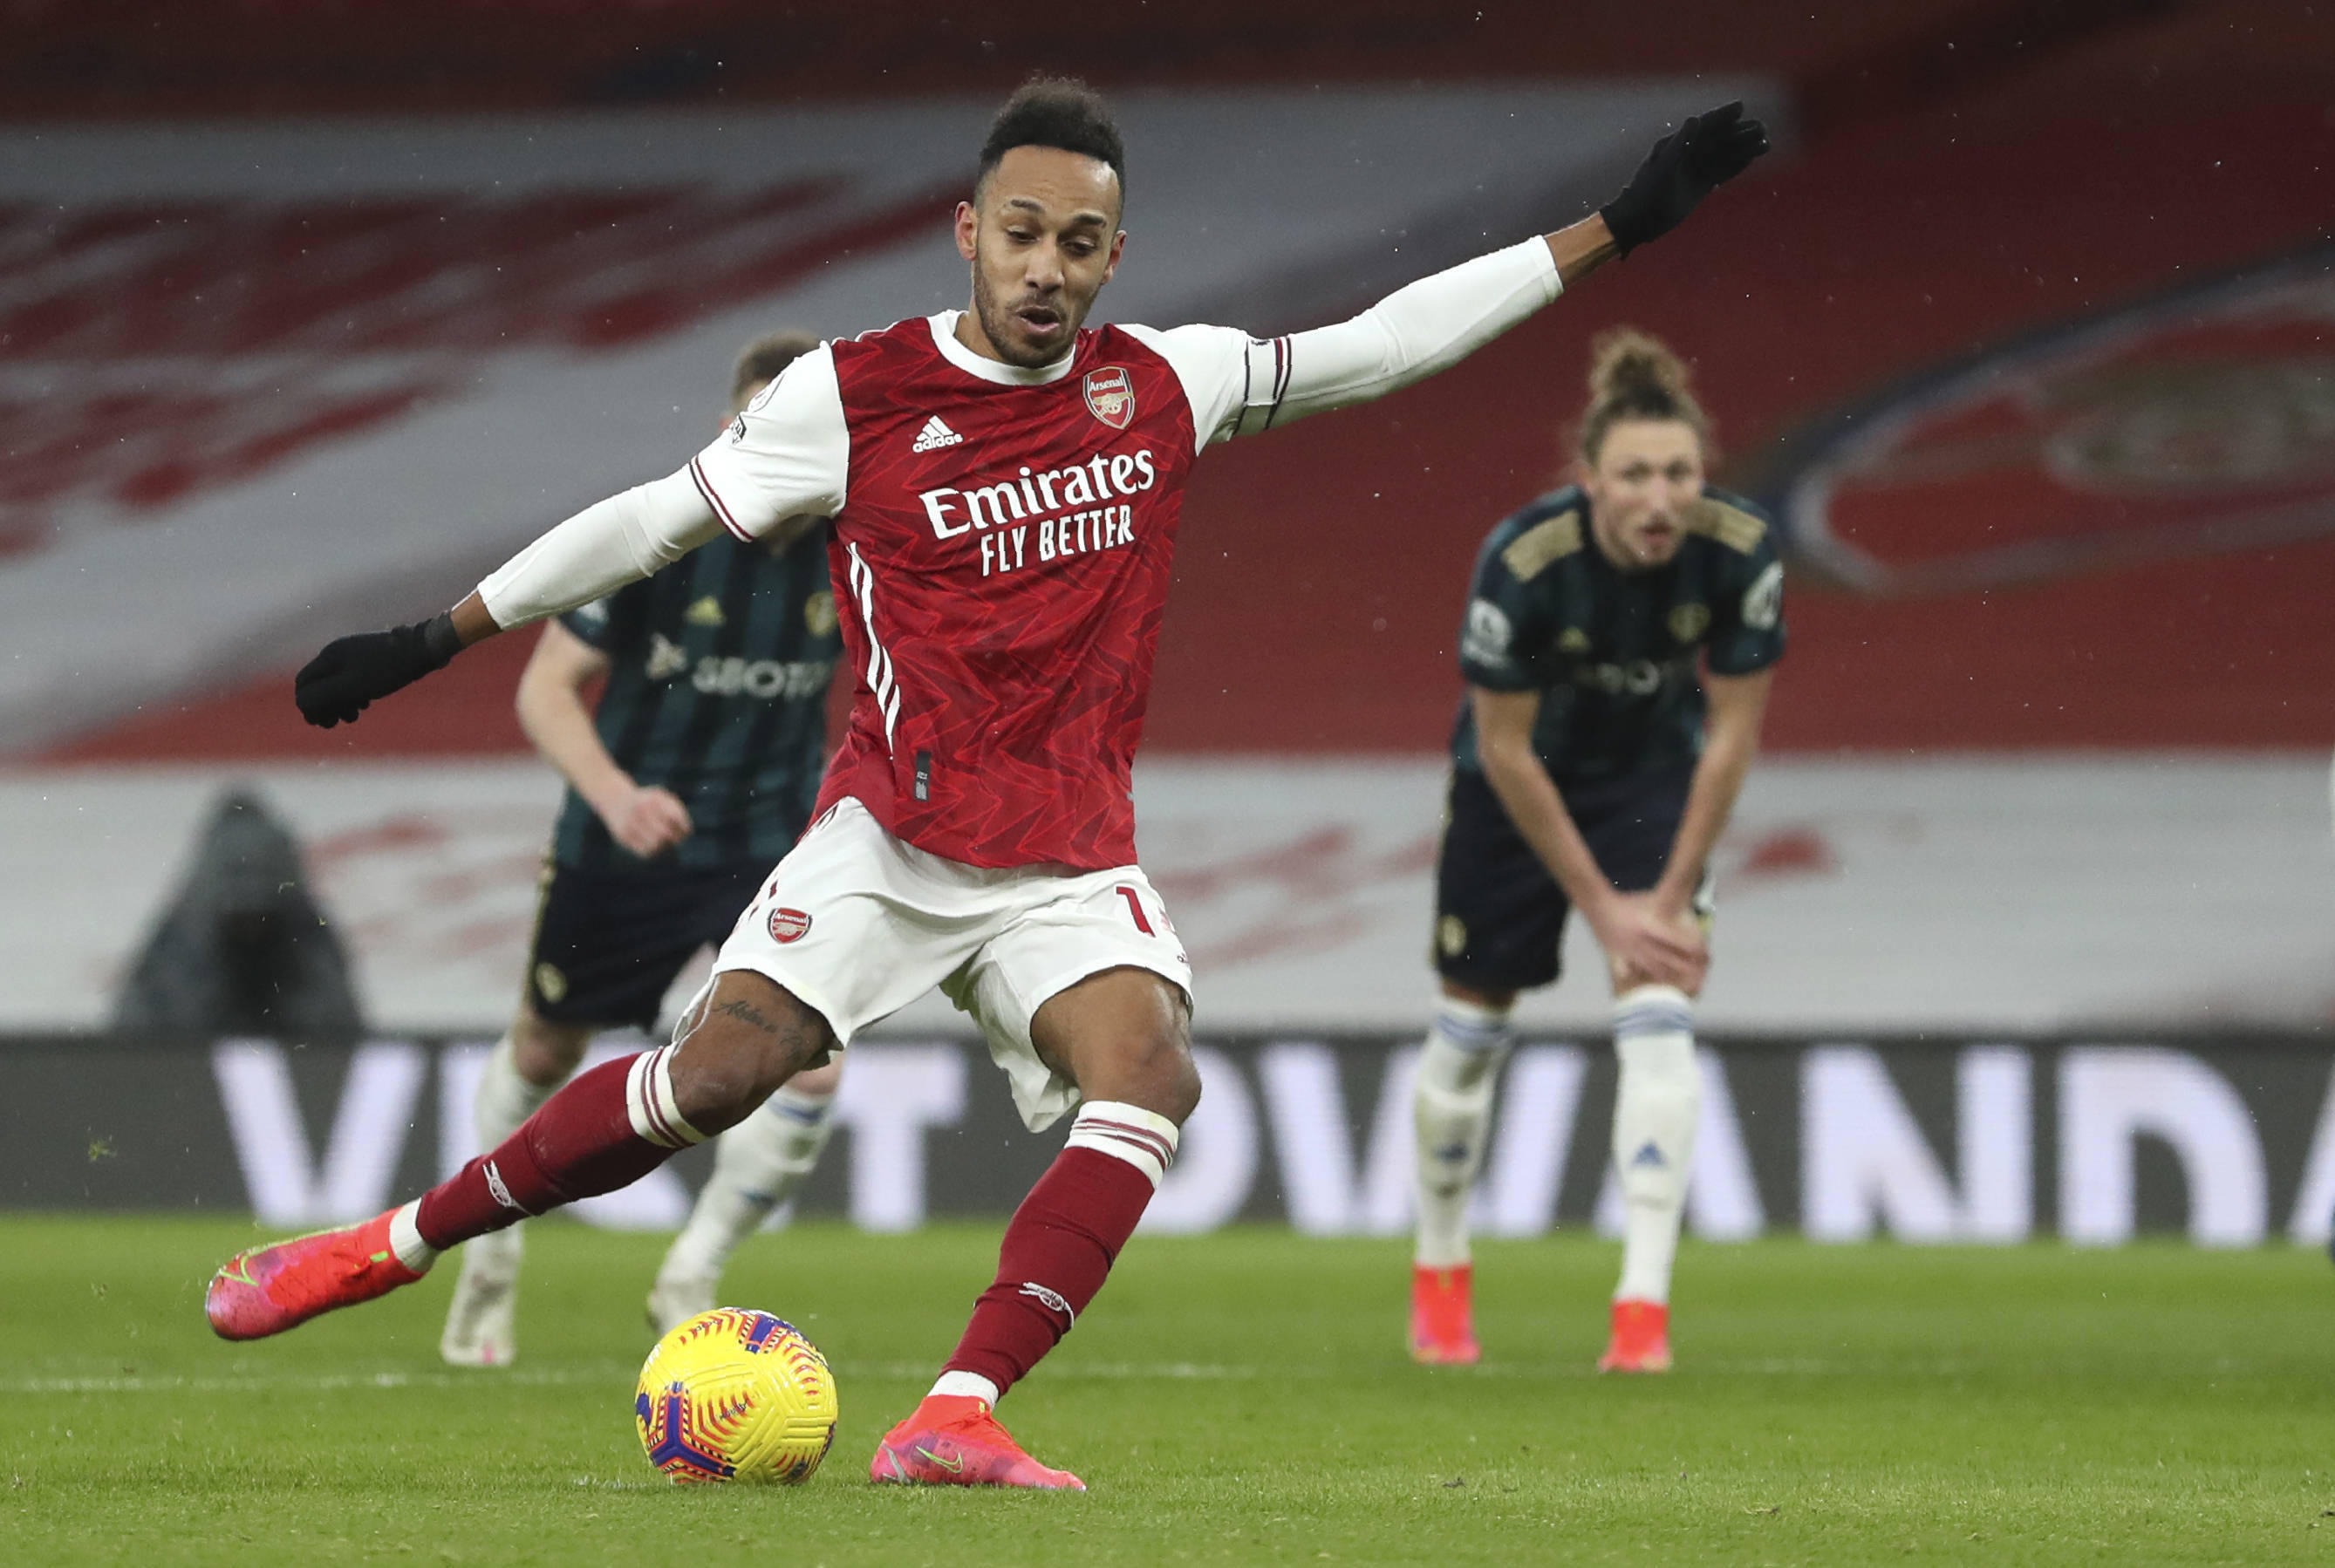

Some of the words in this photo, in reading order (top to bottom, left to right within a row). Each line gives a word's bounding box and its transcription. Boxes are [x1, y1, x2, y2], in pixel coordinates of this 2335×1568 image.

[1089, 376, 1124, 392] Arsenal
[912, 433, 963, 453] adidas
[919, 448, 1155, 540] Emirates
[979, 526, 1026, 576] FLY
[1039, 504, 1135, 562] BETTER
